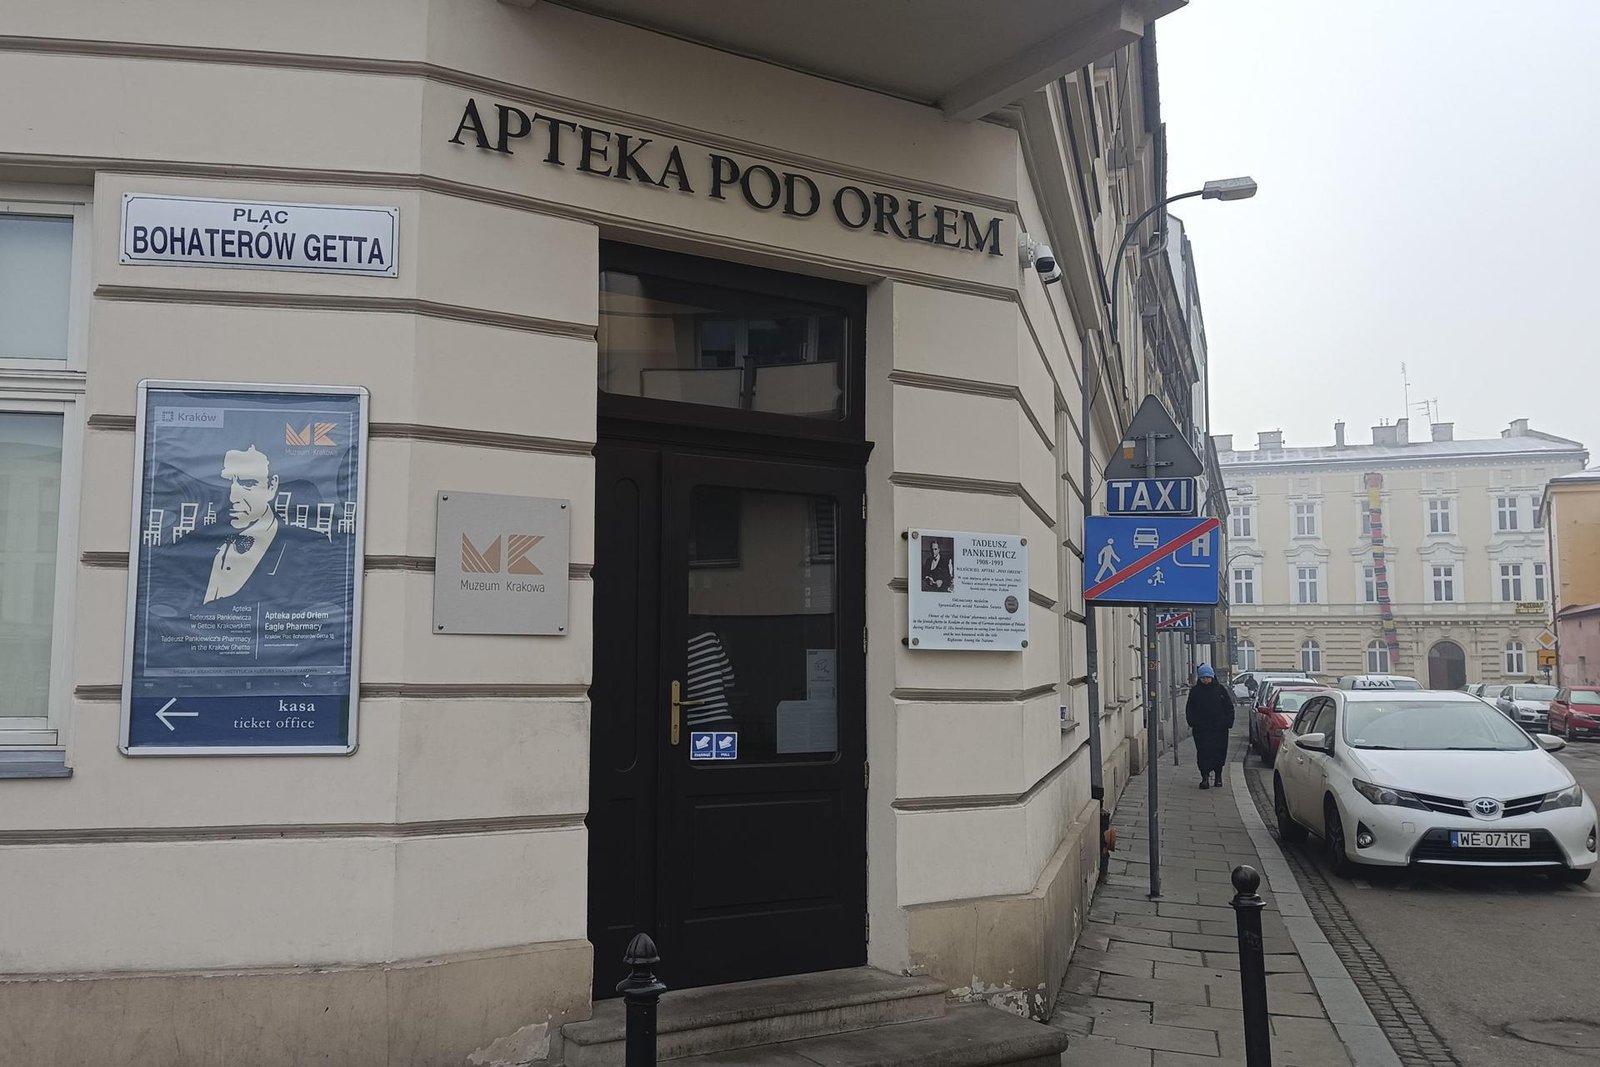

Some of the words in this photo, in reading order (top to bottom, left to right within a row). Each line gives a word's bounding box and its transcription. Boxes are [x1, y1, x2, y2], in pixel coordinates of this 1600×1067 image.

[448, 97, 695, 194] APTEKA
[708, 152, 821, 217] POD
[833, 185, 1004, 257] ORŁEM
[233, 207, 289, 224] PLAC
[132, 224, 296, 260] BOHATERÓW
[303, 233, 385, 265] GETTA
[177, 412, 217, 423] Kraków
[1112, 480, 1187, 511] TAXI
[973, 539, 1007, 548] TADEUSZ
[962, 548, 1016, 559] PANKIEWICZ
[460, 579, 500, 591] Muzeum
[506, 580, 545, 592] Krakowa
[265, 611, 290, 620] Apteka
[291, 612, 305, 620] pod
[1156, 614, 1189, 626] TAXI
[265, 623, 284, 632] Eagle
[286, 622, 323, 632] Pharmacy
[222, 635, 251, 643] Pharmacy
[279, 700, 316, 712] kasa
[234, 717, 271, 729] ticket
[276, 717, 315, 729] office
[1460, 833, 1481, 846] WE
[1485, 833, 1528, 847] 071KF
